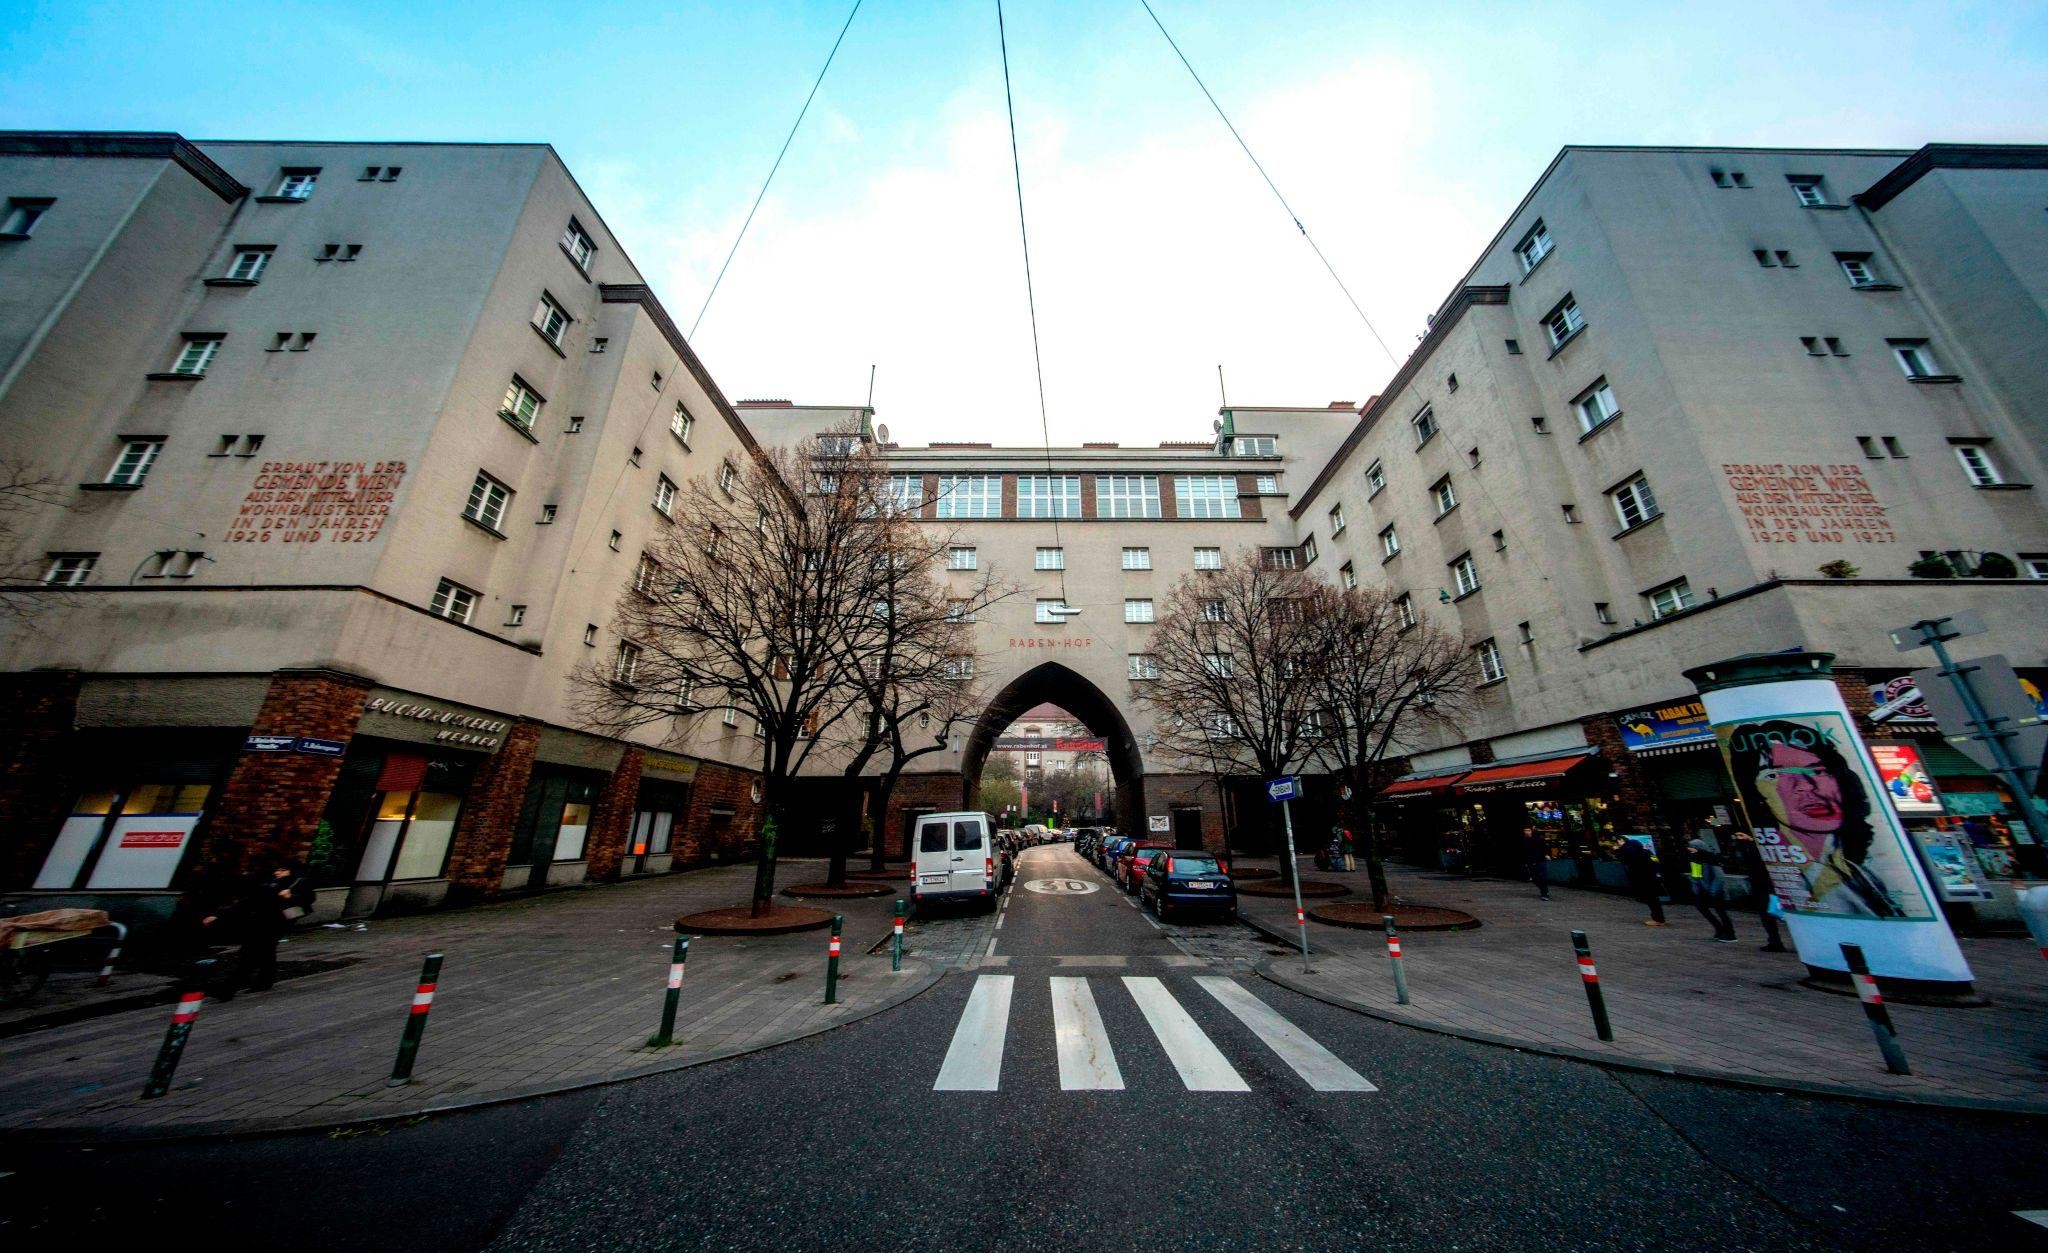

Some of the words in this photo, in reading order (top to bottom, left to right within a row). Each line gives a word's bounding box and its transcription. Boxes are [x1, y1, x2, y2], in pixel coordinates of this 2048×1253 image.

[260, 462, 329, 473] ERBAUT
[332, 462, 366, 473] VON
[373, 461, 407, 474] DER
[1721, 464, 1785, 475] ERBAUT
[1788, 464, 1824, 476] VON
[1828, 464, 1863, 475] DER
[254, 475, 351, 490] GEMEINDE
[356, 475, 403, 490] WIEN
[1728, 476, 1818, 491] GEMEINDE
[1823, 477, 1872, 491] WIEN
[244, 491, 273, 503] AUS
[276, 491, 305, 503] DEN
[306, 491, 366, 503] MITTELN
[366, 491, 394, 503] DER
[1735, 492, 1762, 503] AUS
[1763, 492, 1792, 504] DEN
[1794, 492, 1847, 504] MITTELN
[1848, 492, 1878, 504] DER
[239, 504, 390, 517] WOHNBAUSTEUER
[1739, 505, 1886, 517] WOHNBAUSTEUER
[231, 517, 253, 529] IN
[261, 517, 300, 529] DEN
[308, 517, 385, 529] JAHREN
[1745, 518, 1767, 530] IN
[1773, 518, 1812, 530] DEN
[1820, 518, 1892, 530] JAHREN
[224, 531, 272, 543] 1926
[282, 531, 322, 543] UND
[331, 530, 379, 543] 1927
[1751, 531, 1798, 543] 1926
[1805, 531, 1844, 543] UND
[1852, 531, 1897, 543] 1927
[1620, 711, 1655, 725] CAMEL
[1655, 704, 1690, 721] TABAK
[437, 730, 498, 747] WERNER
